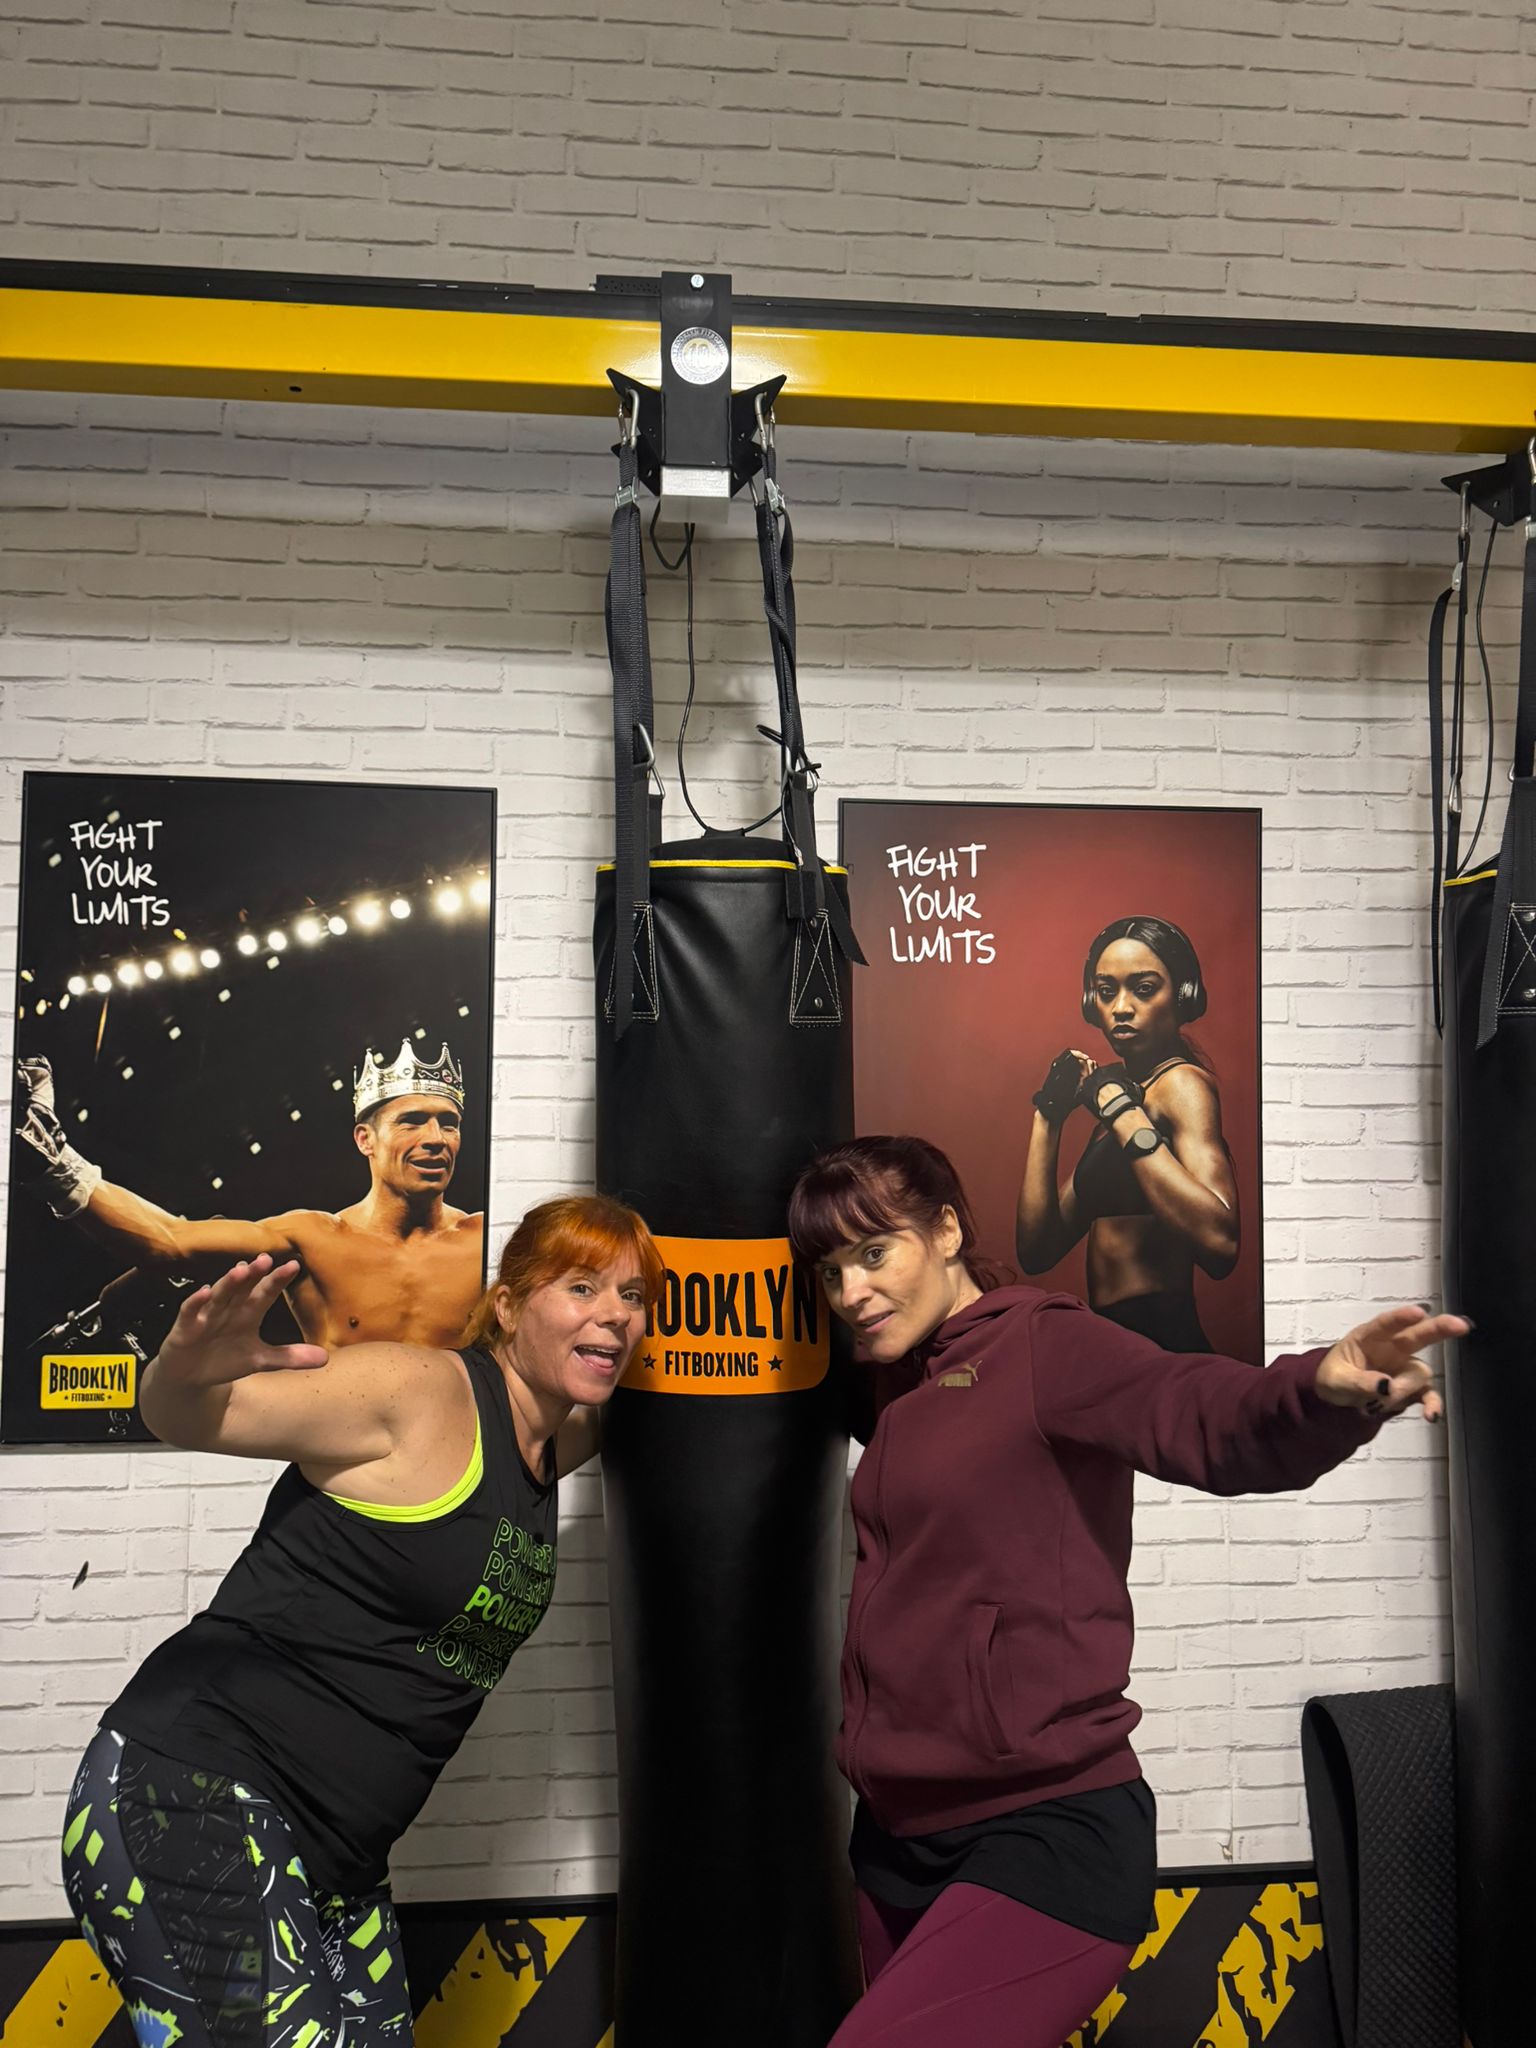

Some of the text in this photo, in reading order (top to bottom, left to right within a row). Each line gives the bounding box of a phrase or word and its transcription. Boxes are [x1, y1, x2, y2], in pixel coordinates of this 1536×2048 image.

[69, 819, 163, 853] FIGHT
[80, 855, 158, 891] YOUR
[886, 843, 987, 881] FIGHT
[72, 892, 170, 926] LIMITS
[898, 883, 982, 924] YOUR
[890, 925, 996, 964] LIMITS
[645, 1260, 818, 1345] OOKLYN
[49, 1361, 128, 1394] BROOKLYN
[665, 1350, 759, 1377] FITBOXING
[71, 1393, 105, 1402] FITBOXING
